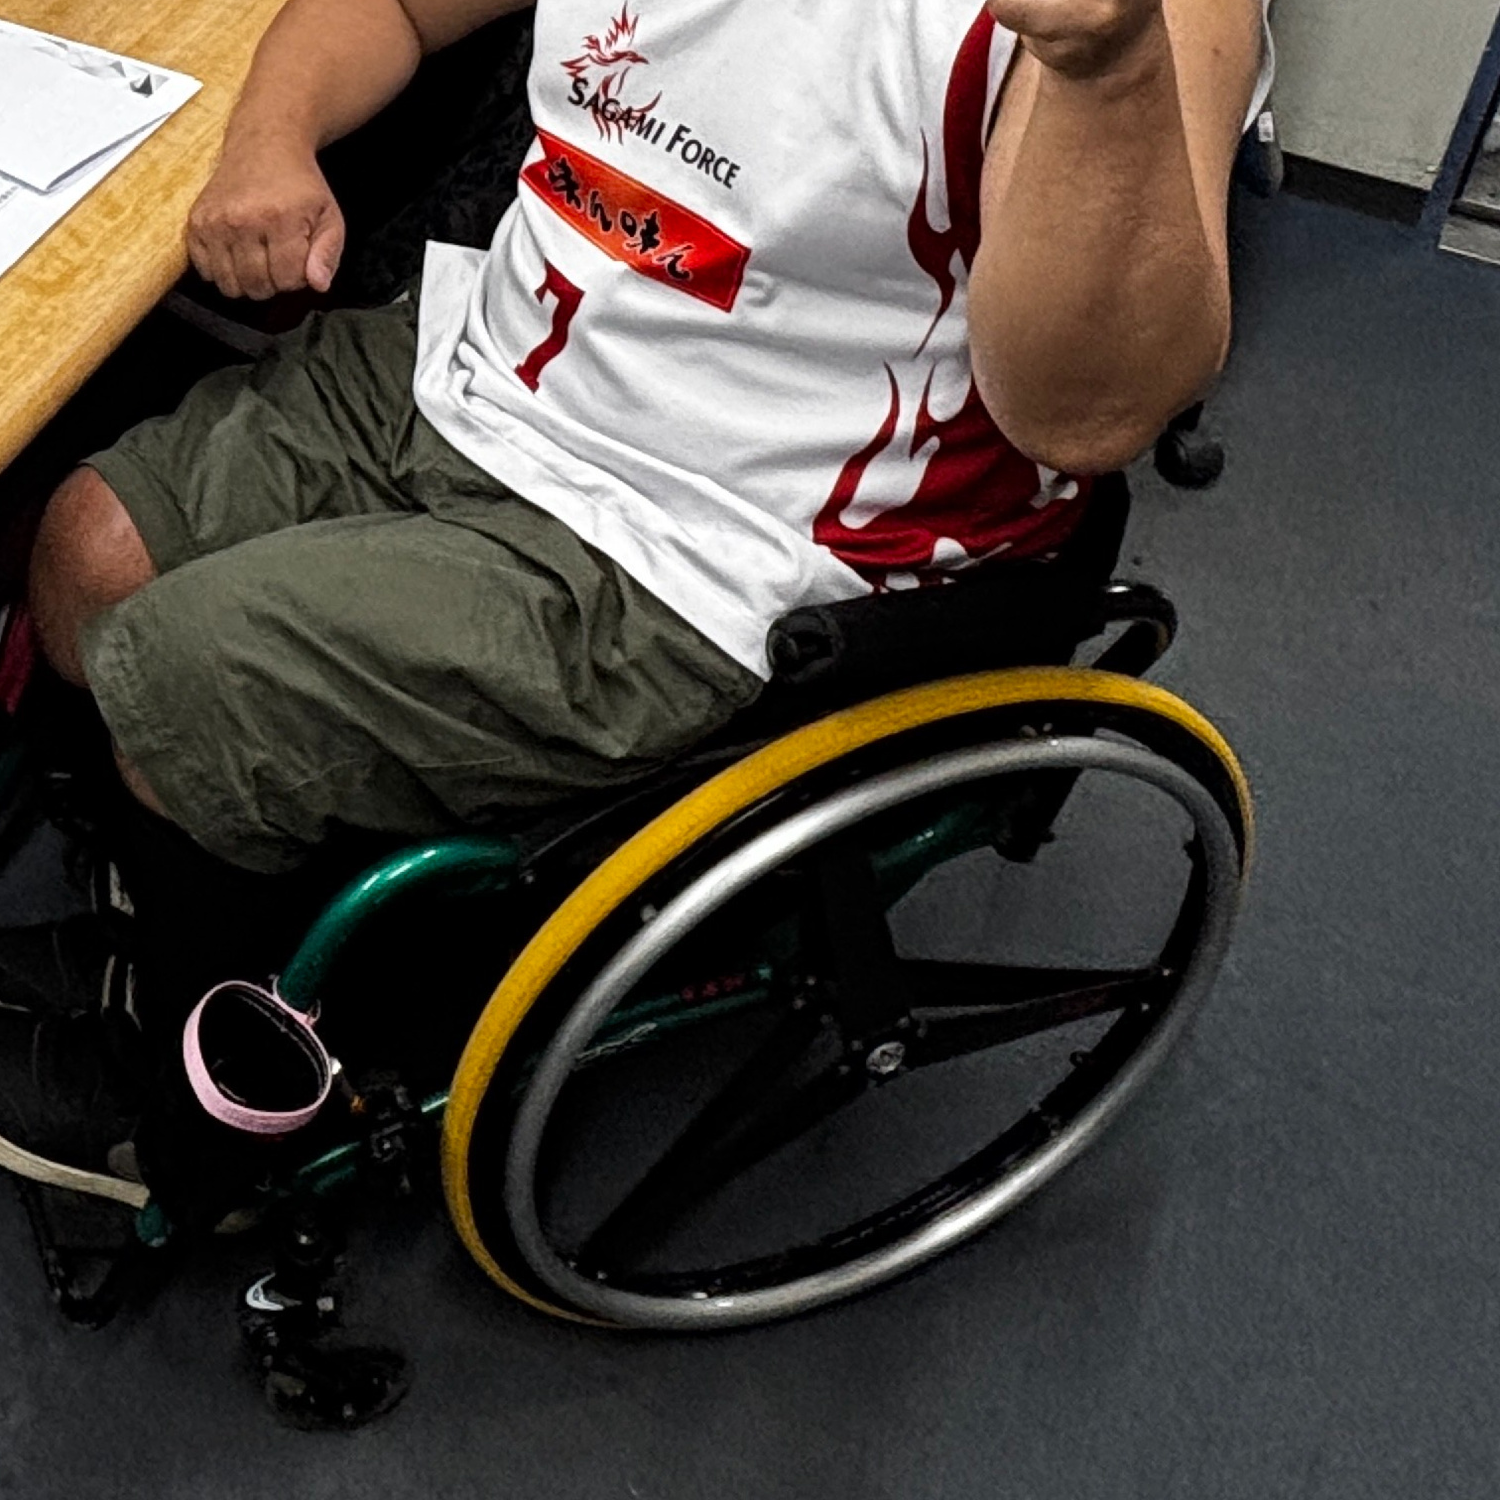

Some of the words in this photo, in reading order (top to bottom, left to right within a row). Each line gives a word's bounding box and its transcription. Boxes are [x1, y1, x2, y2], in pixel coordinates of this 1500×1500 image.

[567, 77, 666, 145] SAGAMI
[665, 123, 741, 190] FORCE
[514, 257, 586, 393] 7
